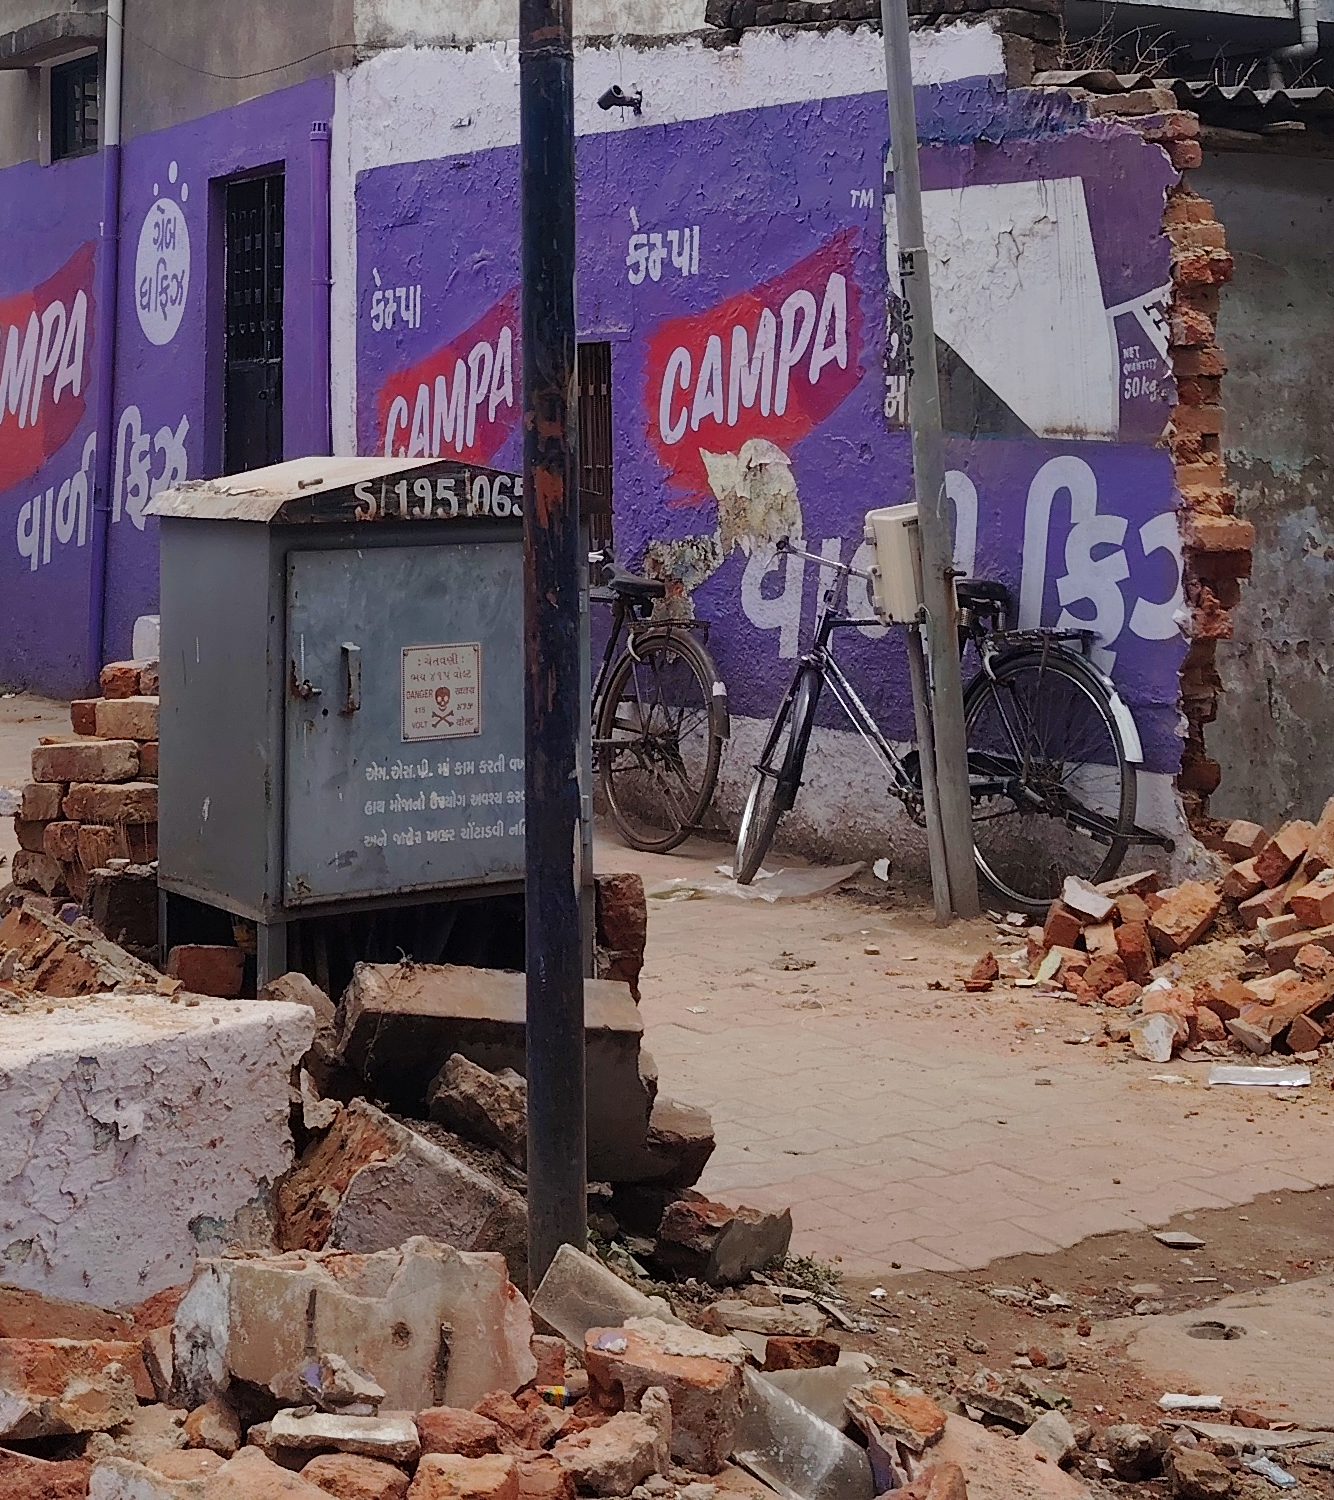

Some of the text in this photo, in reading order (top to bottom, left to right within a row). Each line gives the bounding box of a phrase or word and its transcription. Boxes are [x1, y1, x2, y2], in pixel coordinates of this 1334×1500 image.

[850, 188, 874, 209] TM
[659, 272, 848, 445] CAMPA
[1123, 345, 1140, 359] NET
[384, 325, 514, 458] CAMPA
[406, 689, 434, 699] DANGER
